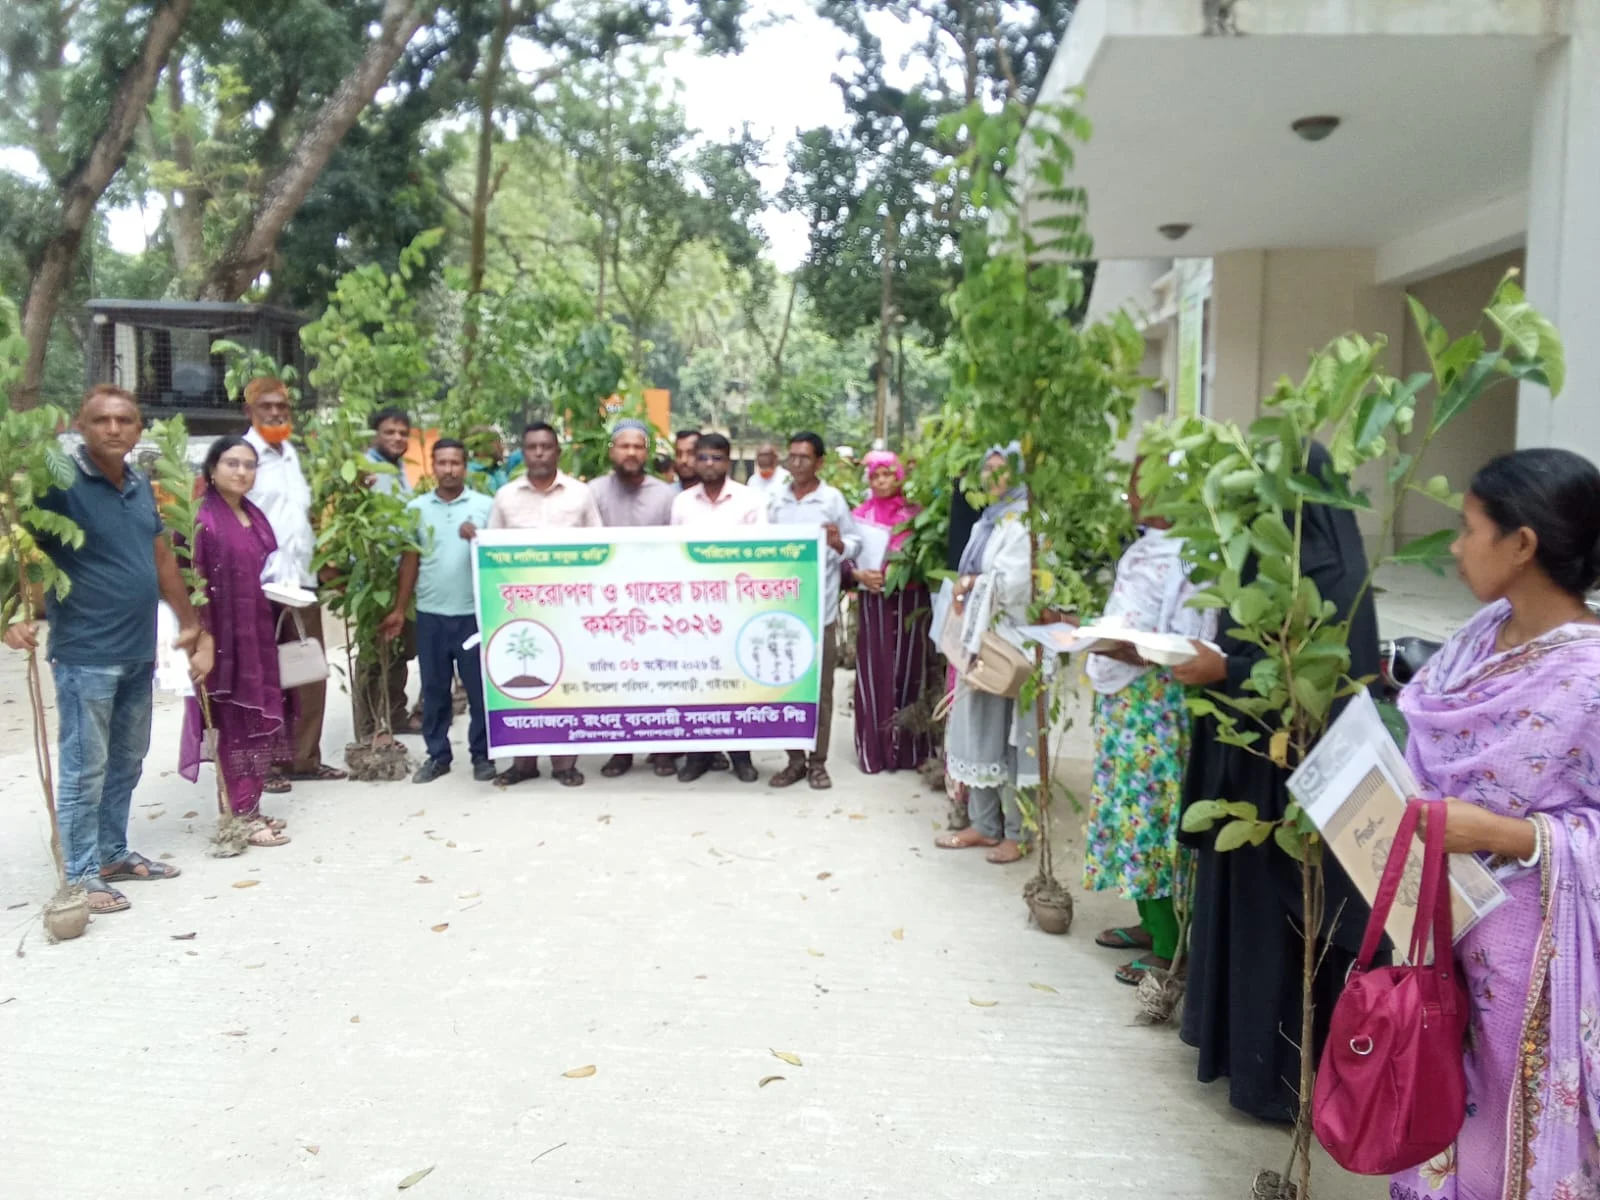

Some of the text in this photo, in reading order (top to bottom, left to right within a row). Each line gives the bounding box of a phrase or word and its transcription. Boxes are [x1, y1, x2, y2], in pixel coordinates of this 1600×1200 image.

[499, 572, 800, 613] বৃক্ষরোপণ ও গাছের চারা বিতরণ
[619, 658, 640, 671] ০৬
[581, 713, 623, 729] রংধনু
[624, 707, 681, 727] ব্যবসায়ী
[683, 710, 733, 725] সমবায়
[734, 705, 781, 724] সমিতি
